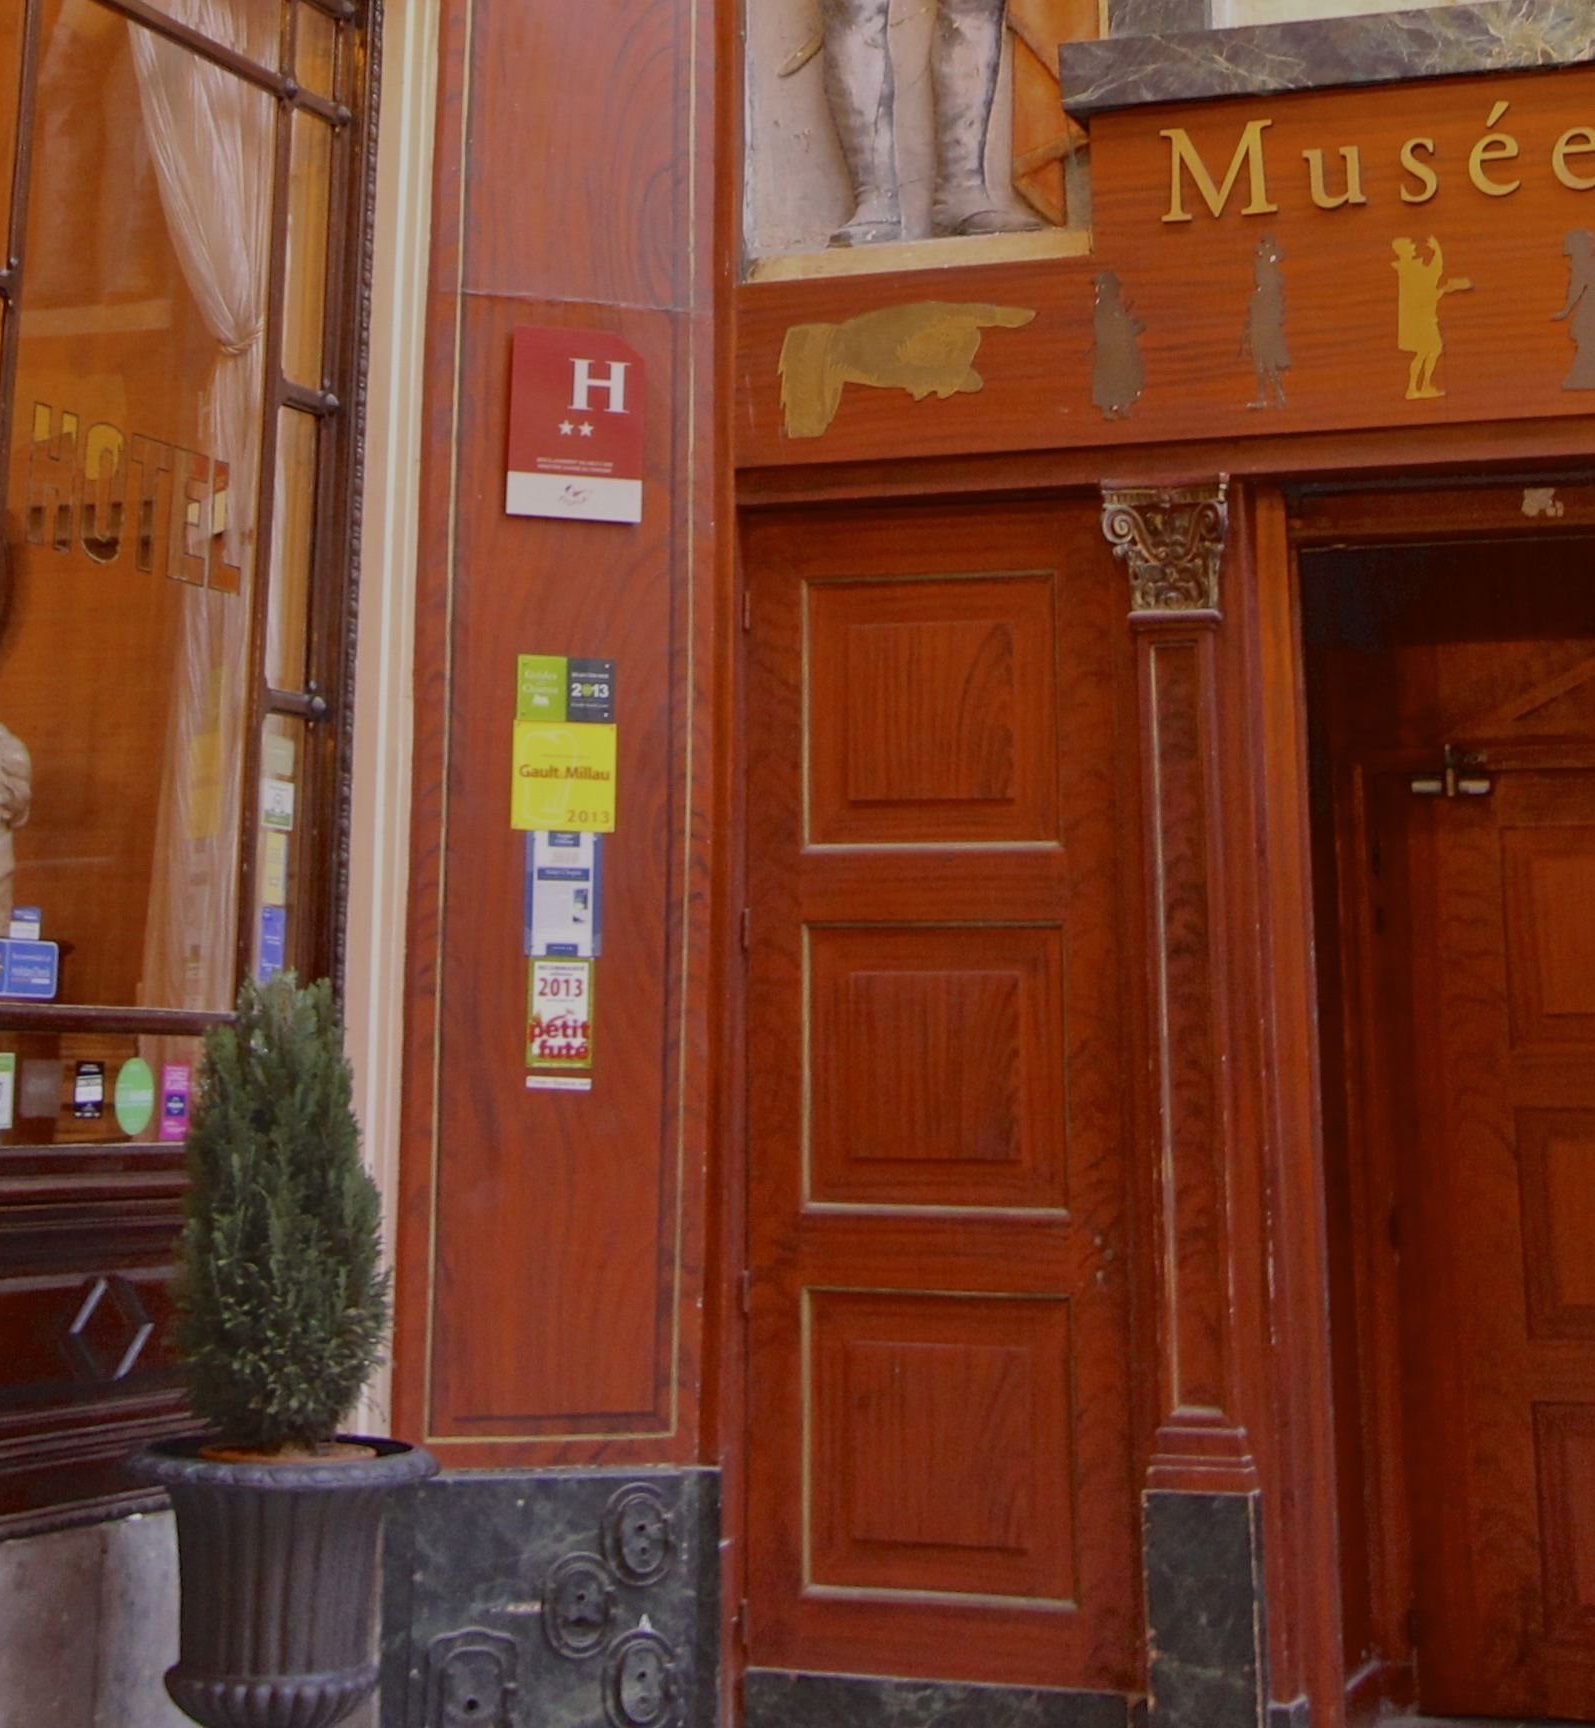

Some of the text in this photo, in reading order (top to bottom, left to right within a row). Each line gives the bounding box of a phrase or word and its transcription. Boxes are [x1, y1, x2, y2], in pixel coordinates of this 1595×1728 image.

[1159, 100, 1595, 223] Musée
[567, 357, 632, 414] H
[24, 400, 241, 596] HOTEL
[564, 765, 611, 781] Millau
[567, 809, 611, 824] 2013
[538, 977, 583, 998] 2013
[529, 1018, 590, 1044] petit
[539, 1039, 589, 1060] futé
